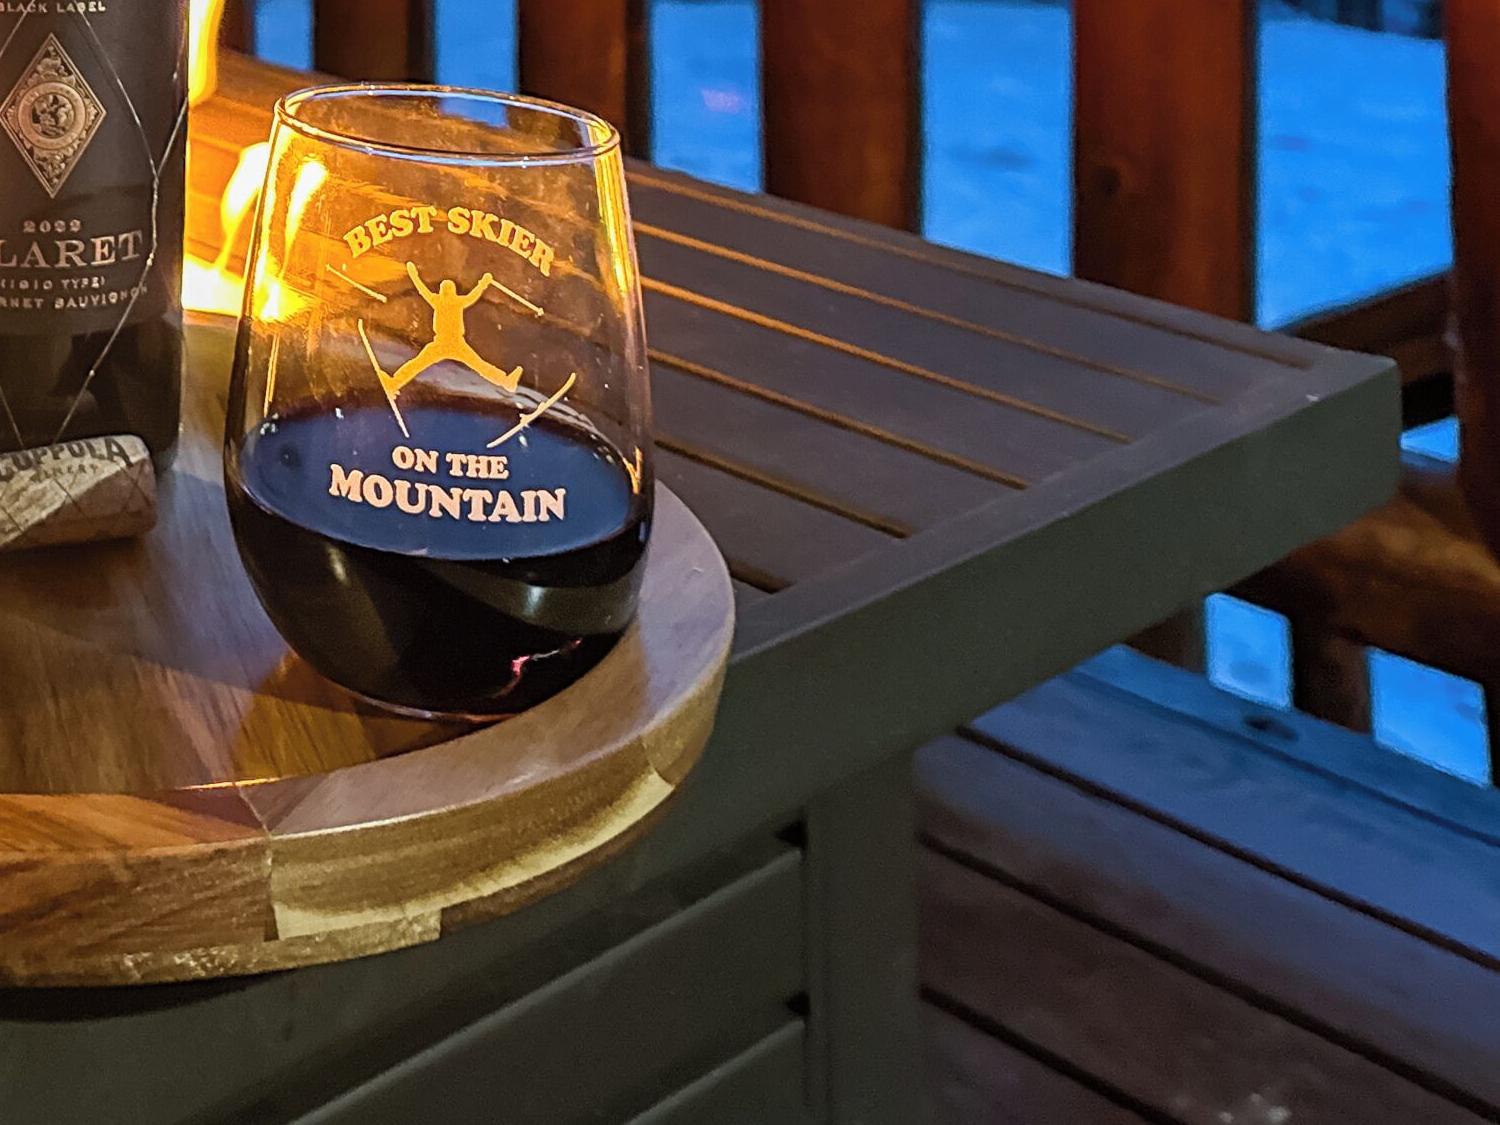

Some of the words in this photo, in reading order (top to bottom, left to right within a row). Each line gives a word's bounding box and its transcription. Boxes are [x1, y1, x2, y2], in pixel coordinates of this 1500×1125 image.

[57, 1, 106, 13] LABEL
[343, 206, 437, 258] BEST
[447, 206, 555, 277] SKIER
[392, 445, 439, 474] ON
[446, 452, 509, 480] THE
[329, 464, 566, 523] MOUNTAIN
